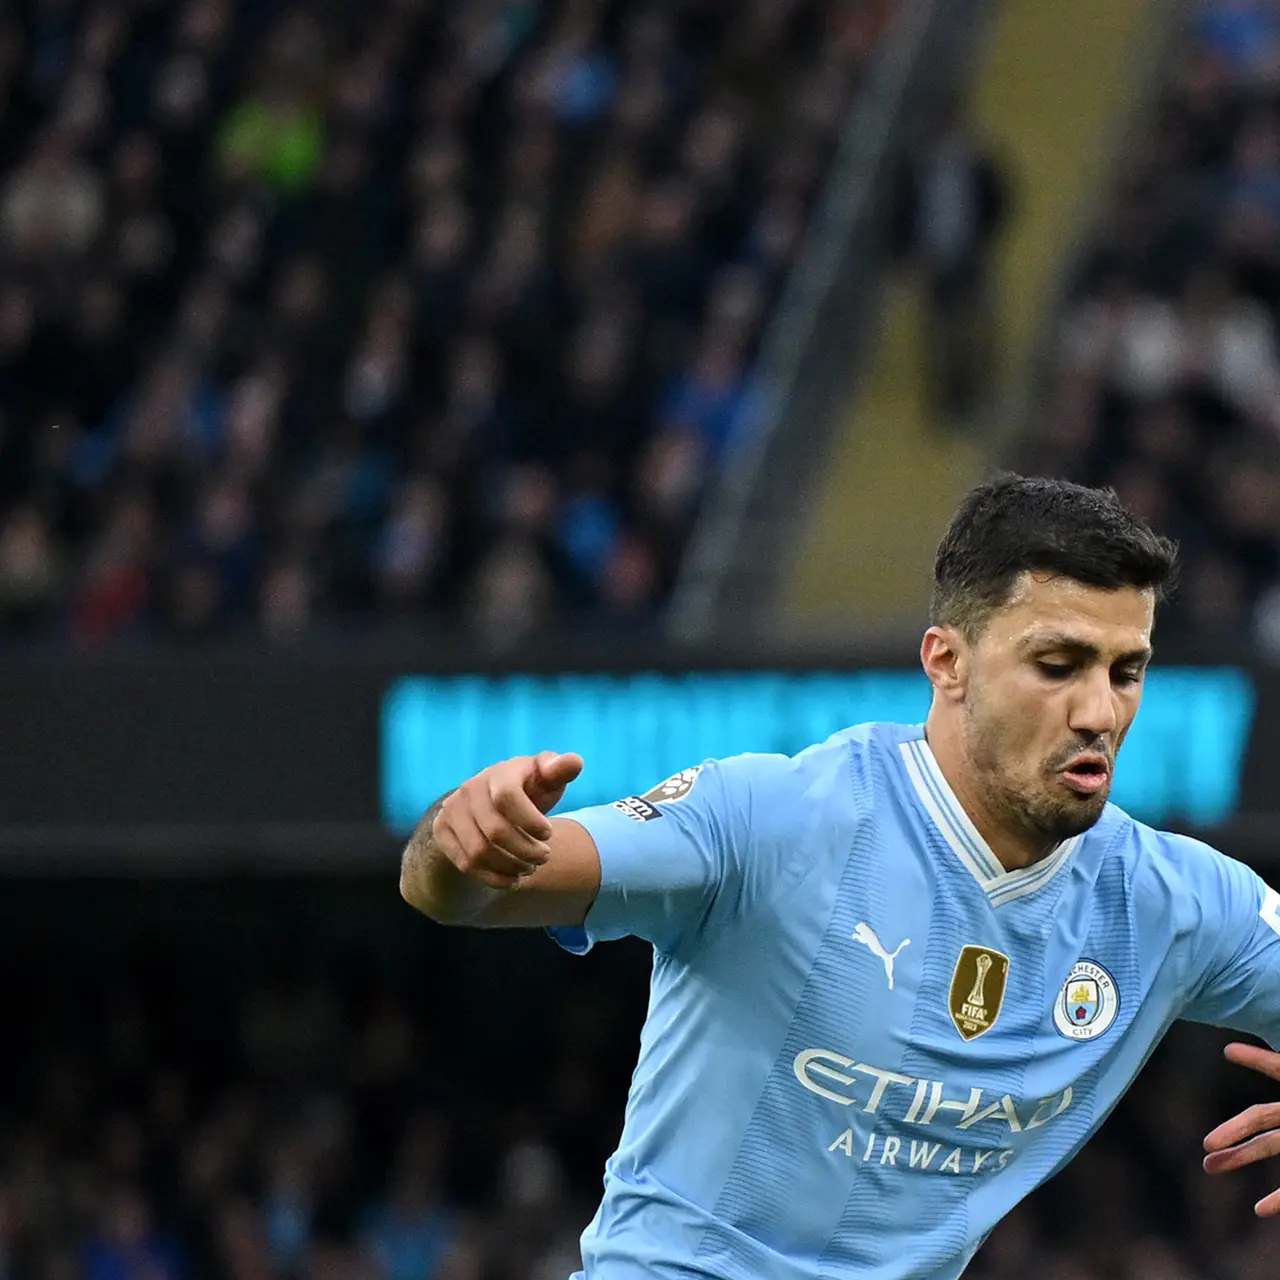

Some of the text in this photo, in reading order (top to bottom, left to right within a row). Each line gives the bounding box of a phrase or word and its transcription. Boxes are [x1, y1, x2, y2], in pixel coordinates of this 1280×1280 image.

[1061, 964, 1110, 992] CHESTER
[961, 1002, 985, 1020] FIFA
[1072, 1027, 1093, 1036] CITY
[793, 1048, 1073, 1133] ETIHAD
[828, 1127, 1014, 1174] AIRWAYS
